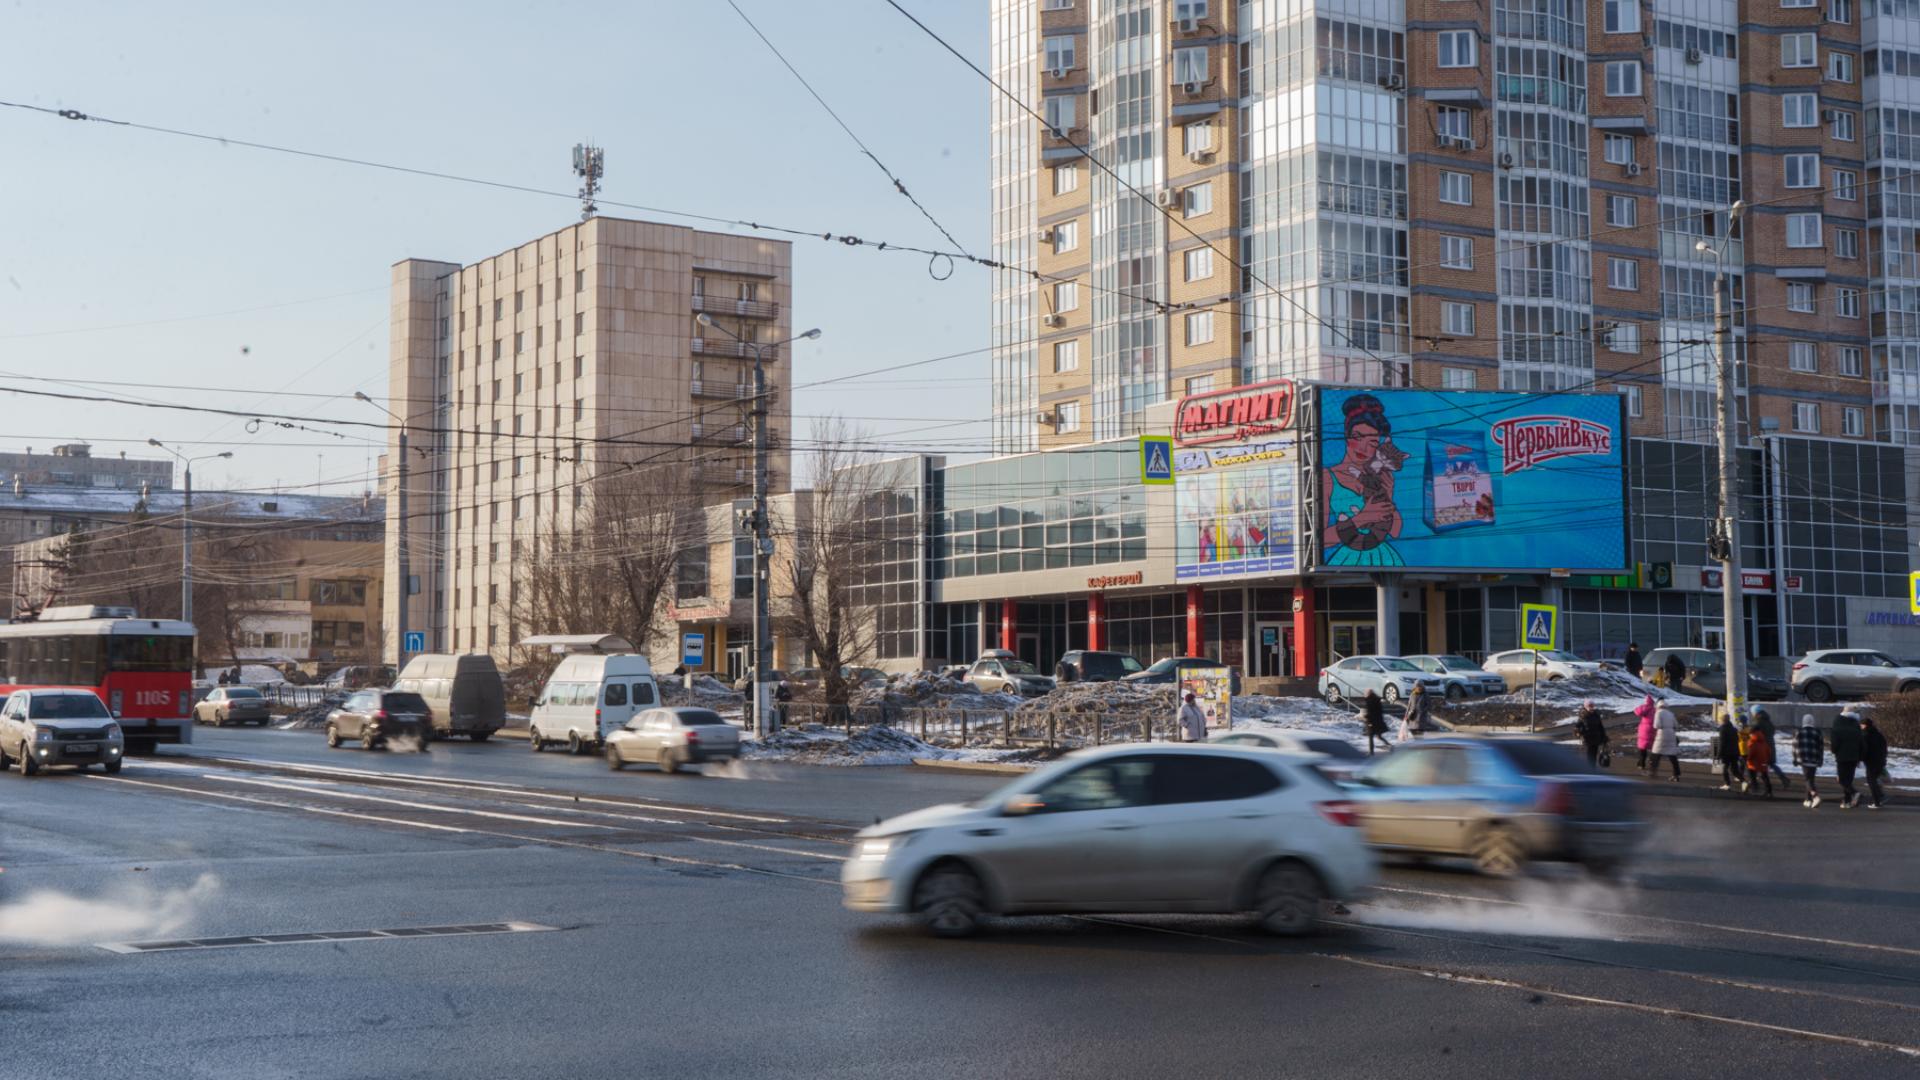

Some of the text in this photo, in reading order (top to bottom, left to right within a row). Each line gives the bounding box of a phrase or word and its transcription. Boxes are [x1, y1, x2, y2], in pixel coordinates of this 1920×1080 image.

[1182, 390, 1286, 432] МАГНИТ
[1452, 481, 1476, 493] ТВОРОГ
[1088, 570, 1142, 588] КАФЕТЕРИЙ
[1744, 575, 1765, 586] БАНК
[136, 690, 170, 705] 1105
